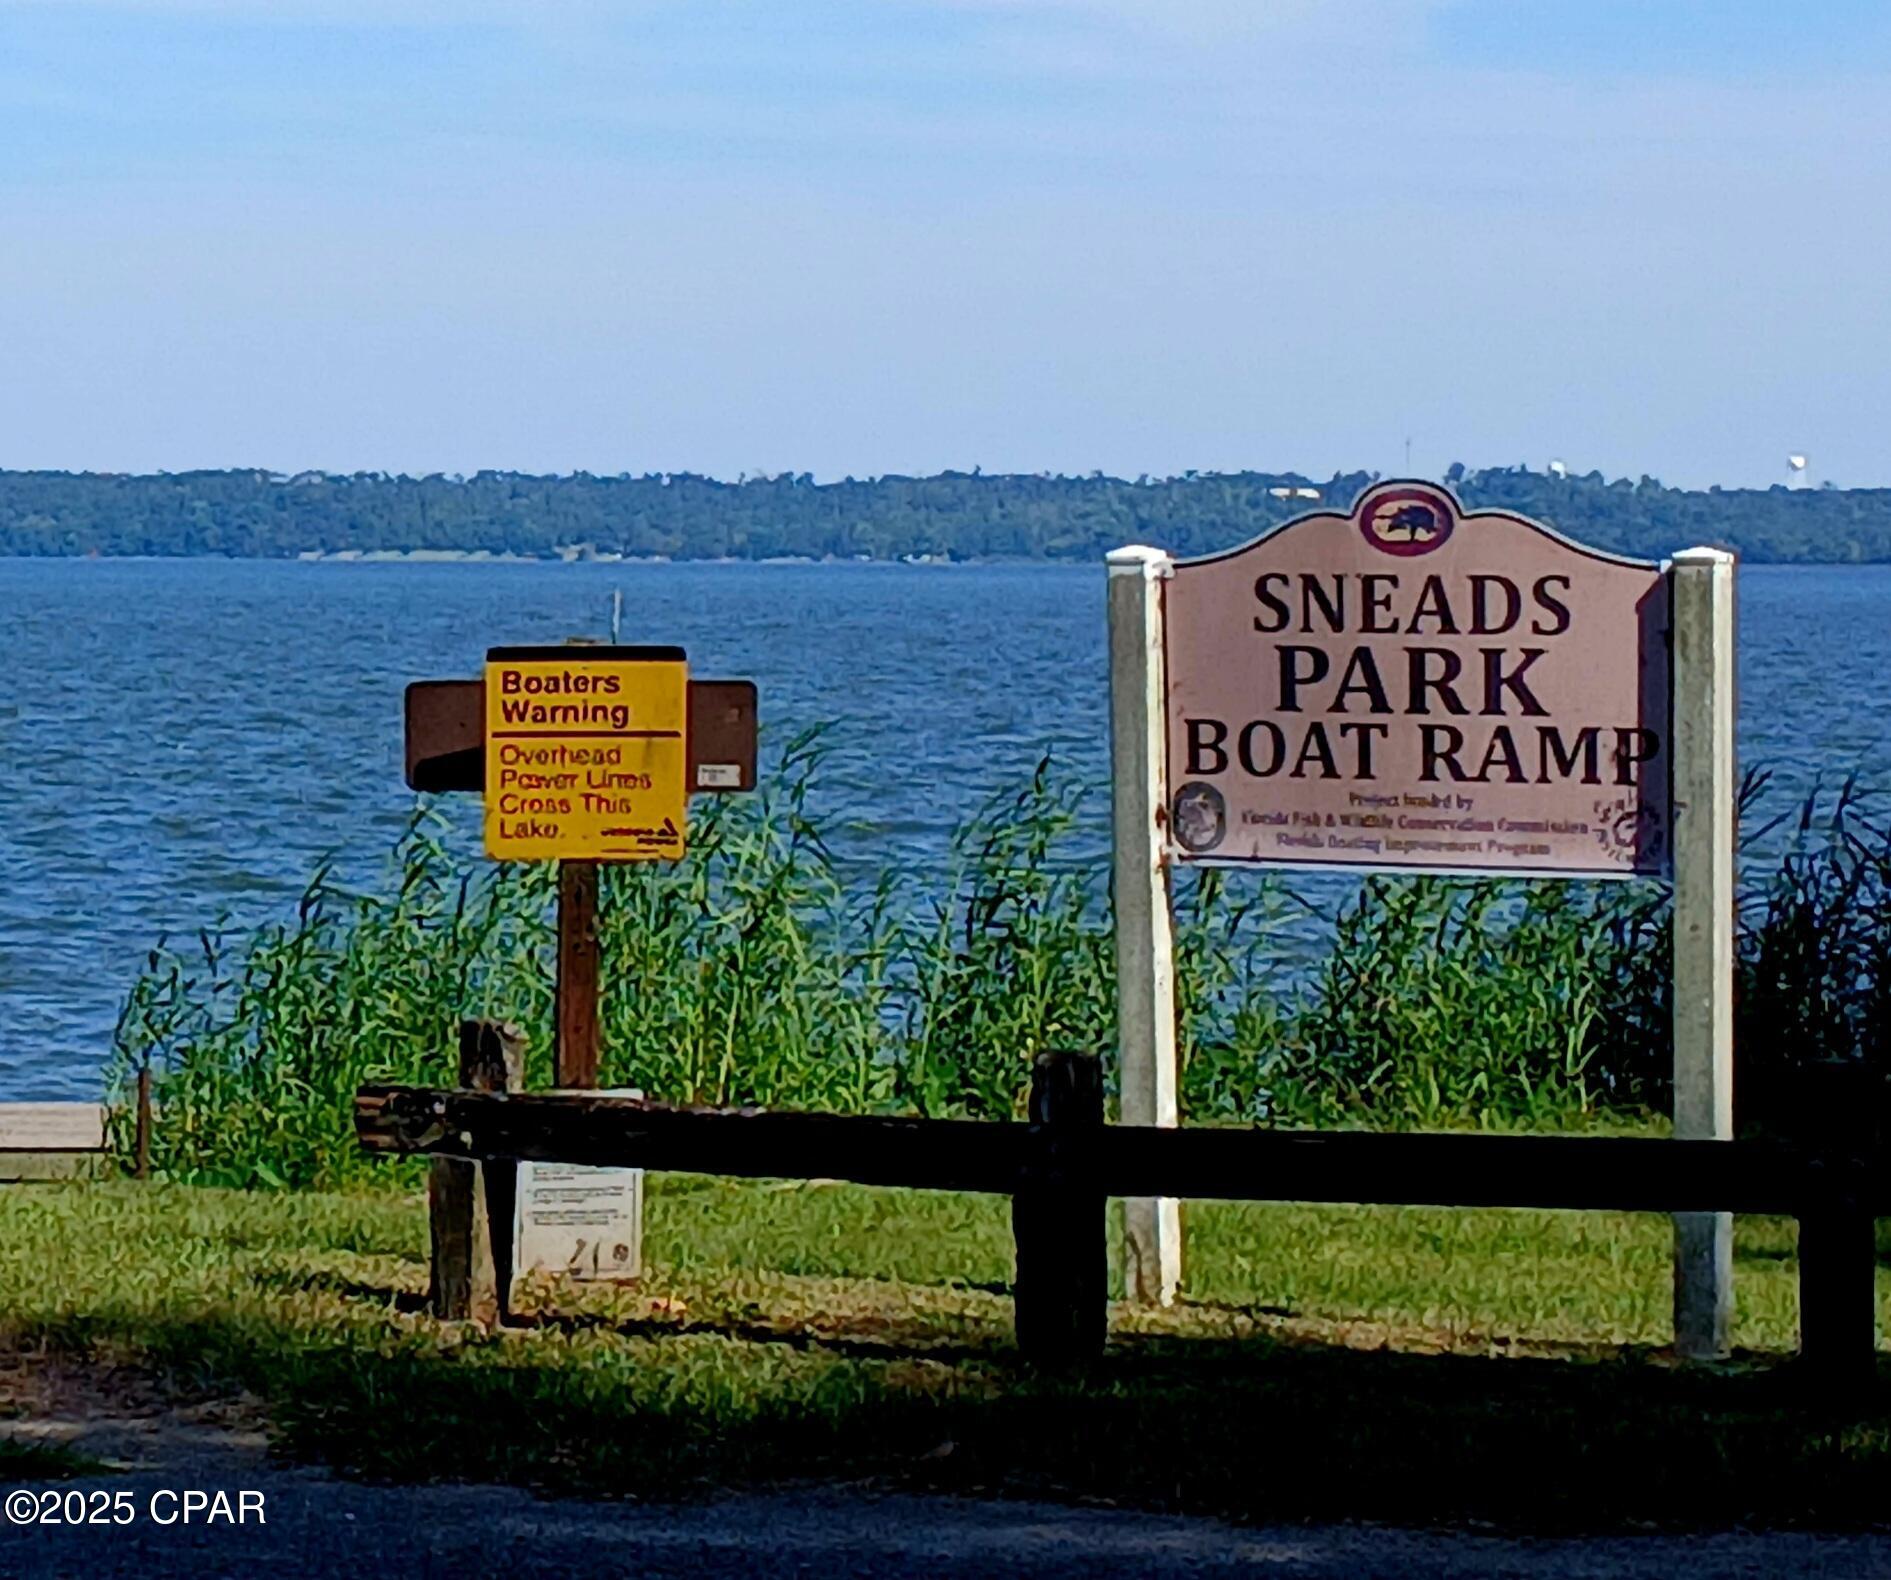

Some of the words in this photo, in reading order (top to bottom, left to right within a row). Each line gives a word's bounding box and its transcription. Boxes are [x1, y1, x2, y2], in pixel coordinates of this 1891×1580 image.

[1253, 572, 1571, 636] SNEADS
[501, 670, 621, 695] Boaters
[1273, 644, 1551, 717] PARK
[501, 699, 630, 729] Warning
[499, 744, 622, 767] Overhead
[1183, 718, 1389, 780] BOAT
[1417, 723, 1660, 787] RAMP
[500, 769, 579, 790] Power
[586, 769, 653, 790] Lines
[499, 793, 572, 815] Cross
[579, 793, 632, 815] This
